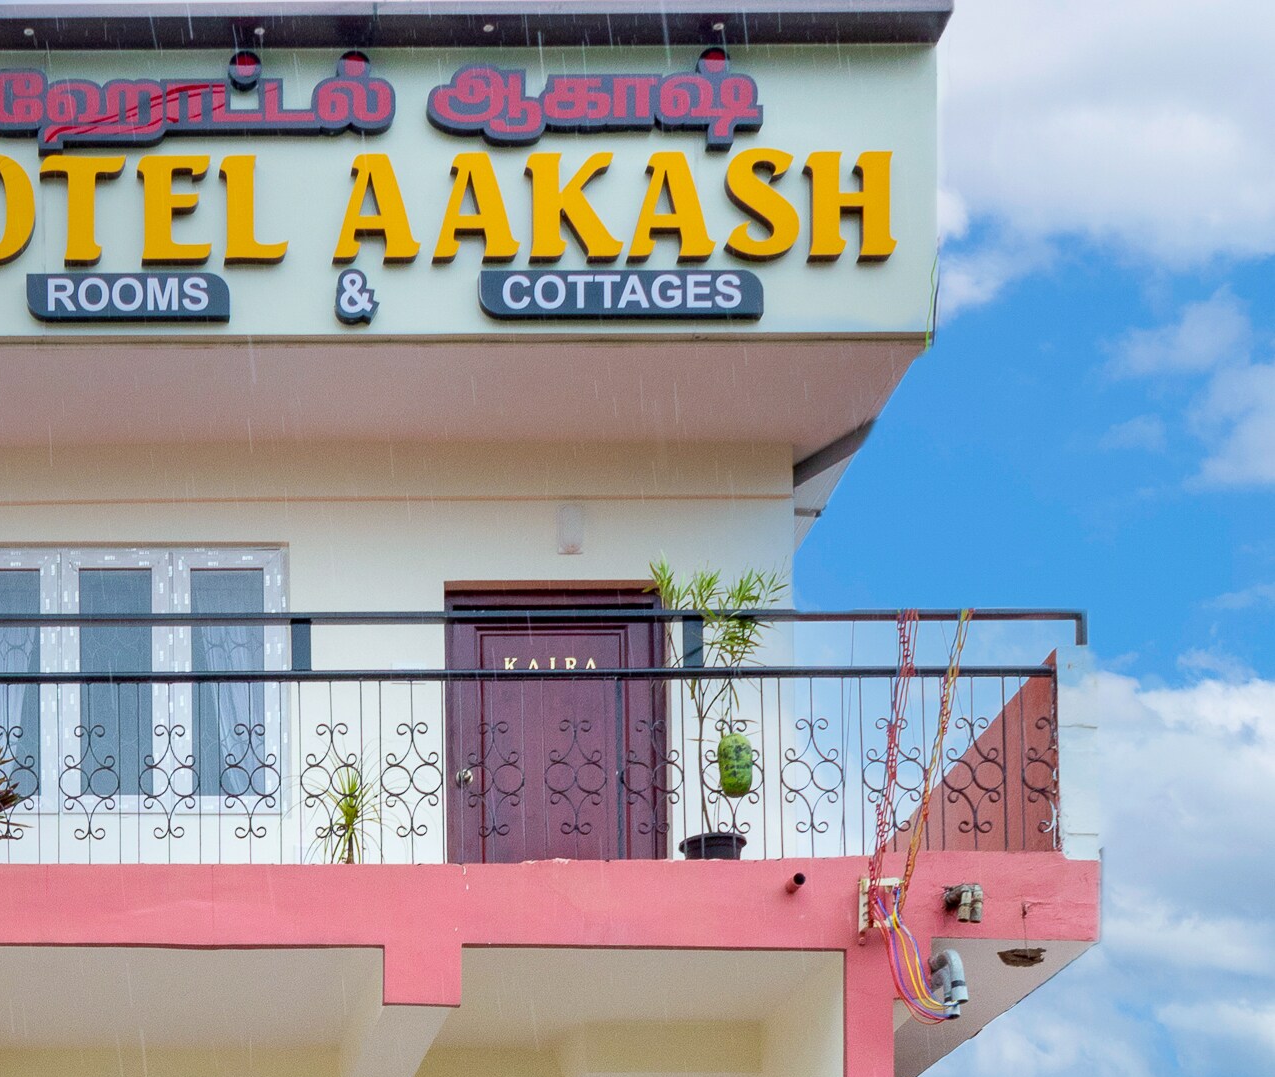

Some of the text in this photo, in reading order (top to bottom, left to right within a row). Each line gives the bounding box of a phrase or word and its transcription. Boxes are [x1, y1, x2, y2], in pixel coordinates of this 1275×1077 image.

[433, 52, 758, 136] ஆகாஷ்
[334, 148, 898, 263] AAKASH
[47, 272, 742, 314] ROOMS & COTTAGES
